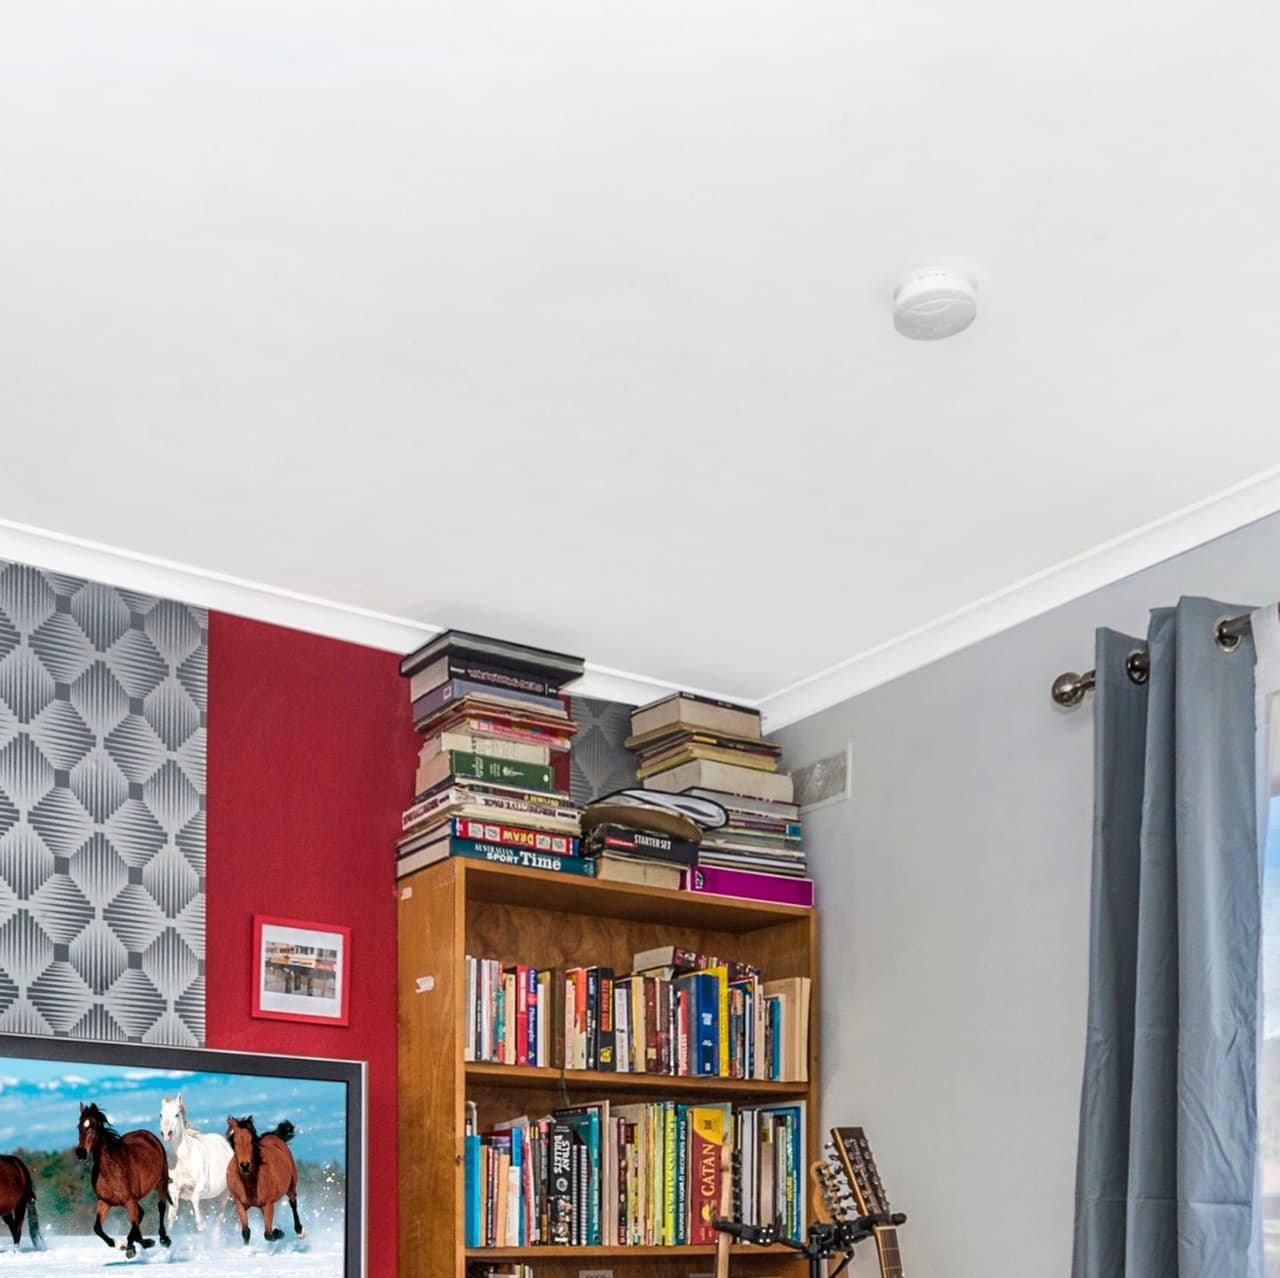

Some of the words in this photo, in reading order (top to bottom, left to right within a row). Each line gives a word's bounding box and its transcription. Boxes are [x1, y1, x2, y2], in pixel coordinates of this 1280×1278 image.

[473, 842, 514, 856] AUSTRALIAN
[502, 830, 535, 846] DRAW
[633, 833, 661, 849] STARTER
[486, 852, 519, 865] SPORT
[519, 850, 562, 871] Time
[553, 1135, 562, 1174] BULLETS
[560, 1140, 571, 1172] STRAY
[679, 1141, 687, 1175] RECORDS
[700, 1142, 716, 1198] CATAN
